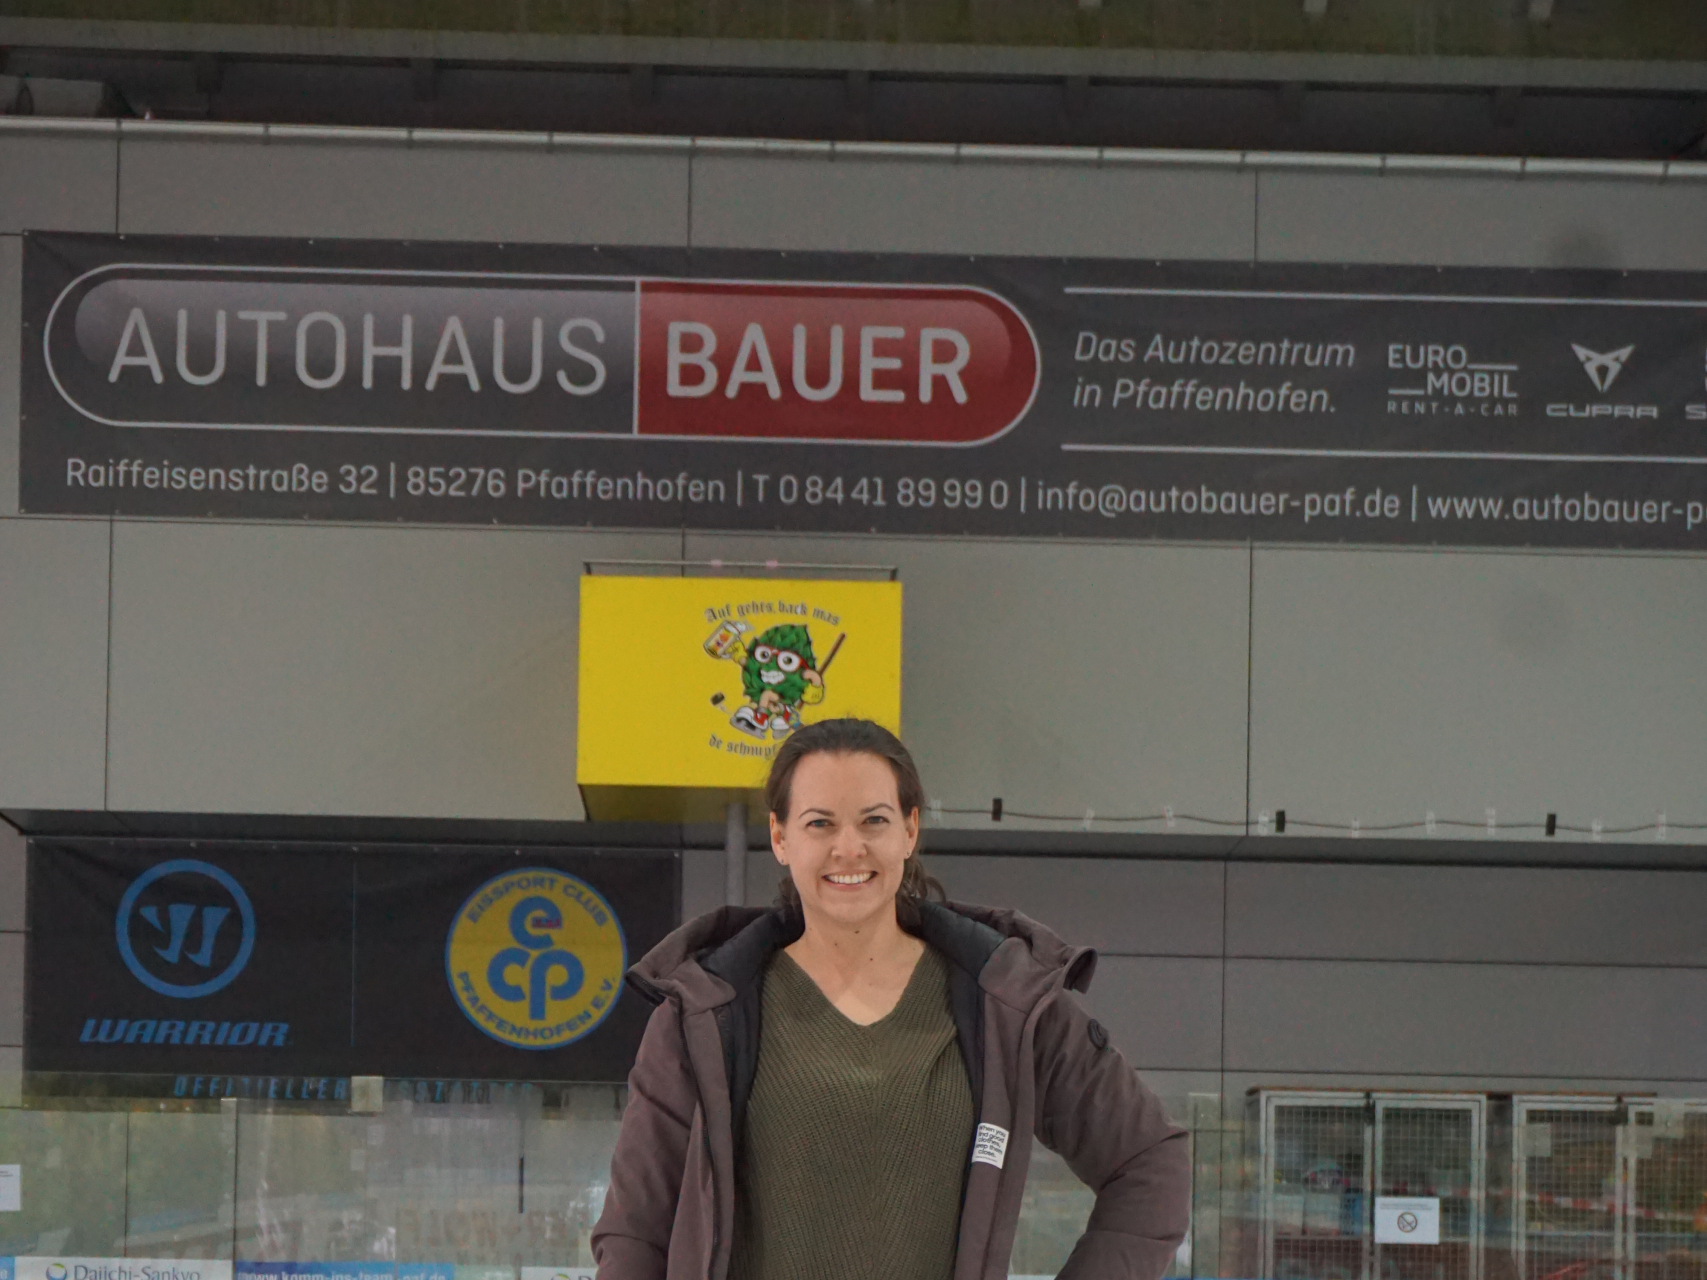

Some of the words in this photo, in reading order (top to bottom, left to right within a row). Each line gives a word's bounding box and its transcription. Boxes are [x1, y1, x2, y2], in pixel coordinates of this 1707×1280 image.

[108, 307, 608, 396] AUTOHAUS
[666, 321, 971, 405] BAUER
[1074, 331, 1136, 362] Das
[1144, 333, 1356, 367] Autozentrum
[1388, 344, 1467, 369] EURO
[1073, 377, 1101, 408] in
[1112, 378, 1336, 413] Pfaffenhofen.
[1426, 371, 1518, 398] MOBIL
[1546, 403, 1659, 419] CUPRA
[66, 457, 328, 492] Raiffeisenstraße
[338, 464, 378, 494] 32
[406, 466, 506, 498] 85276
[517, 468, 725, 502] Pfaffenhofen
[752, 474, 770, 502] T
[1037, 480, 1400, 523] info@autobauer-paf.de
[704, 603, 731, 623] Auf
[466, 875, 557, 924] EISSPORT
[563, 884, 608, 927] CLUB
[456, 971, 592, 1040] PFAFFENHOFEN
[79, 1018, 290, 1047] WARRIOR
